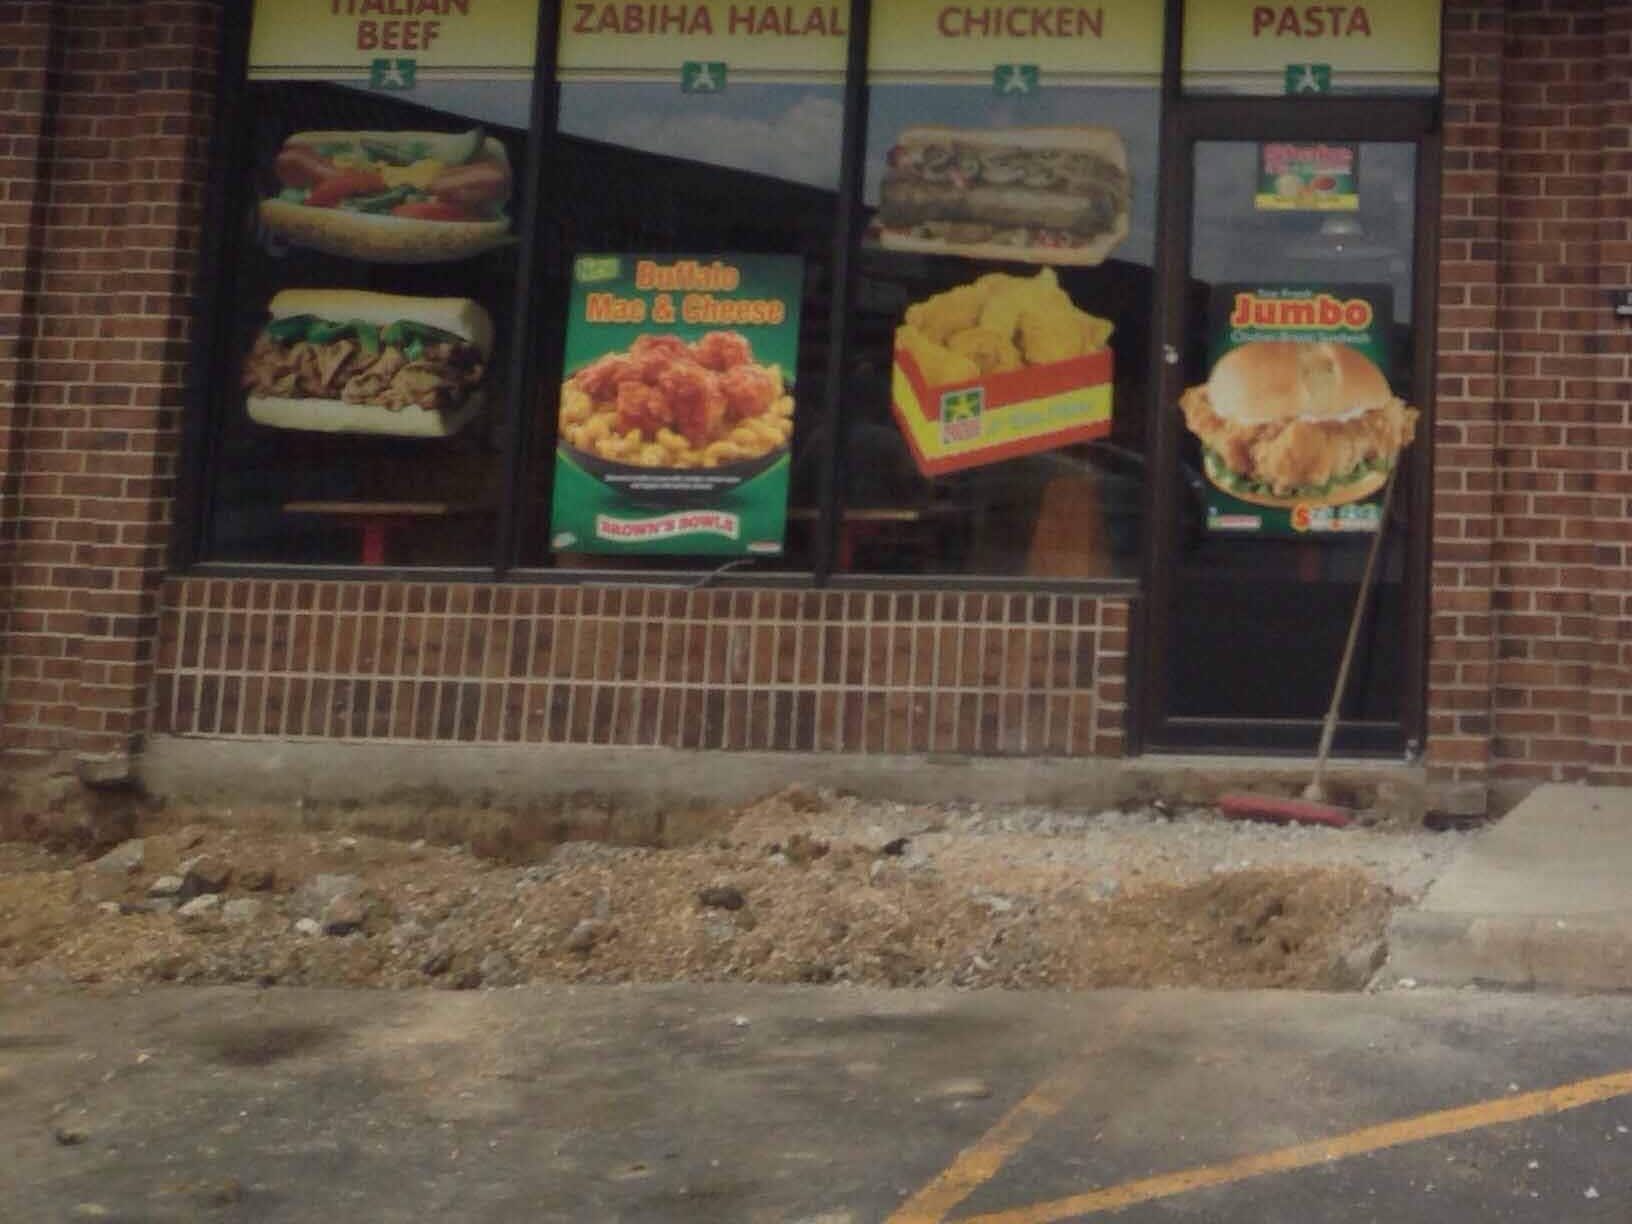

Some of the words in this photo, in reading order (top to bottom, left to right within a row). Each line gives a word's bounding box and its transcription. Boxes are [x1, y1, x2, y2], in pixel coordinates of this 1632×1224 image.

[357, 19, 441, 51] BEEF
[572, 3, 713, 35] ZABIHA
[728, 4, 847, 36] HALAL
[937, 5, 1103, 38] CHICKEN
[1252, 5, 1373, 38] PASTA
[586, 292, 646, 323] Mac
[682, 294, 786, 325] Cheese
[1231, 292, 1374, 330] Jumbo
